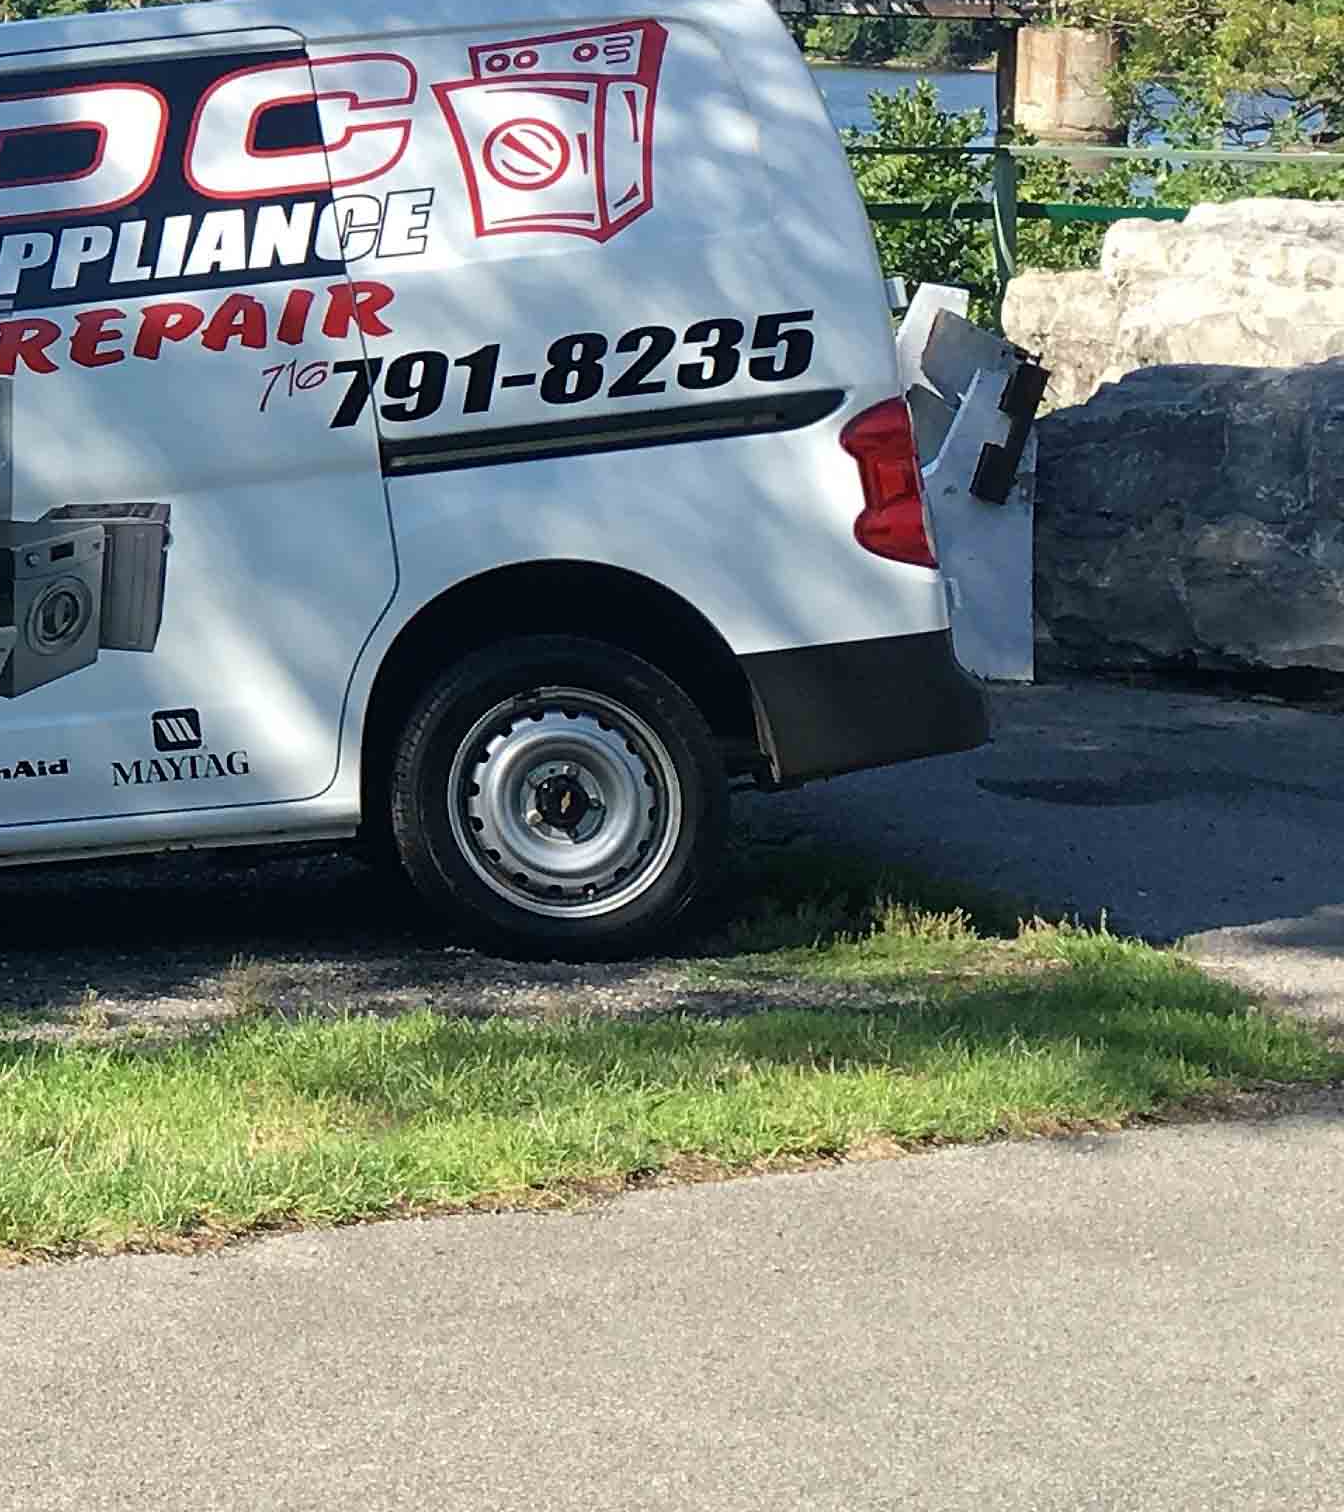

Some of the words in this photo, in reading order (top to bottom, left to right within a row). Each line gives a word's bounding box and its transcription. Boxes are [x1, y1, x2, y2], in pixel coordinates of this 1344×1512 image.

[258, 359, 330, 412] 716
[328, 309, 815, 430] 791-8235
[110, 750, 250, 789] MAYTAG
